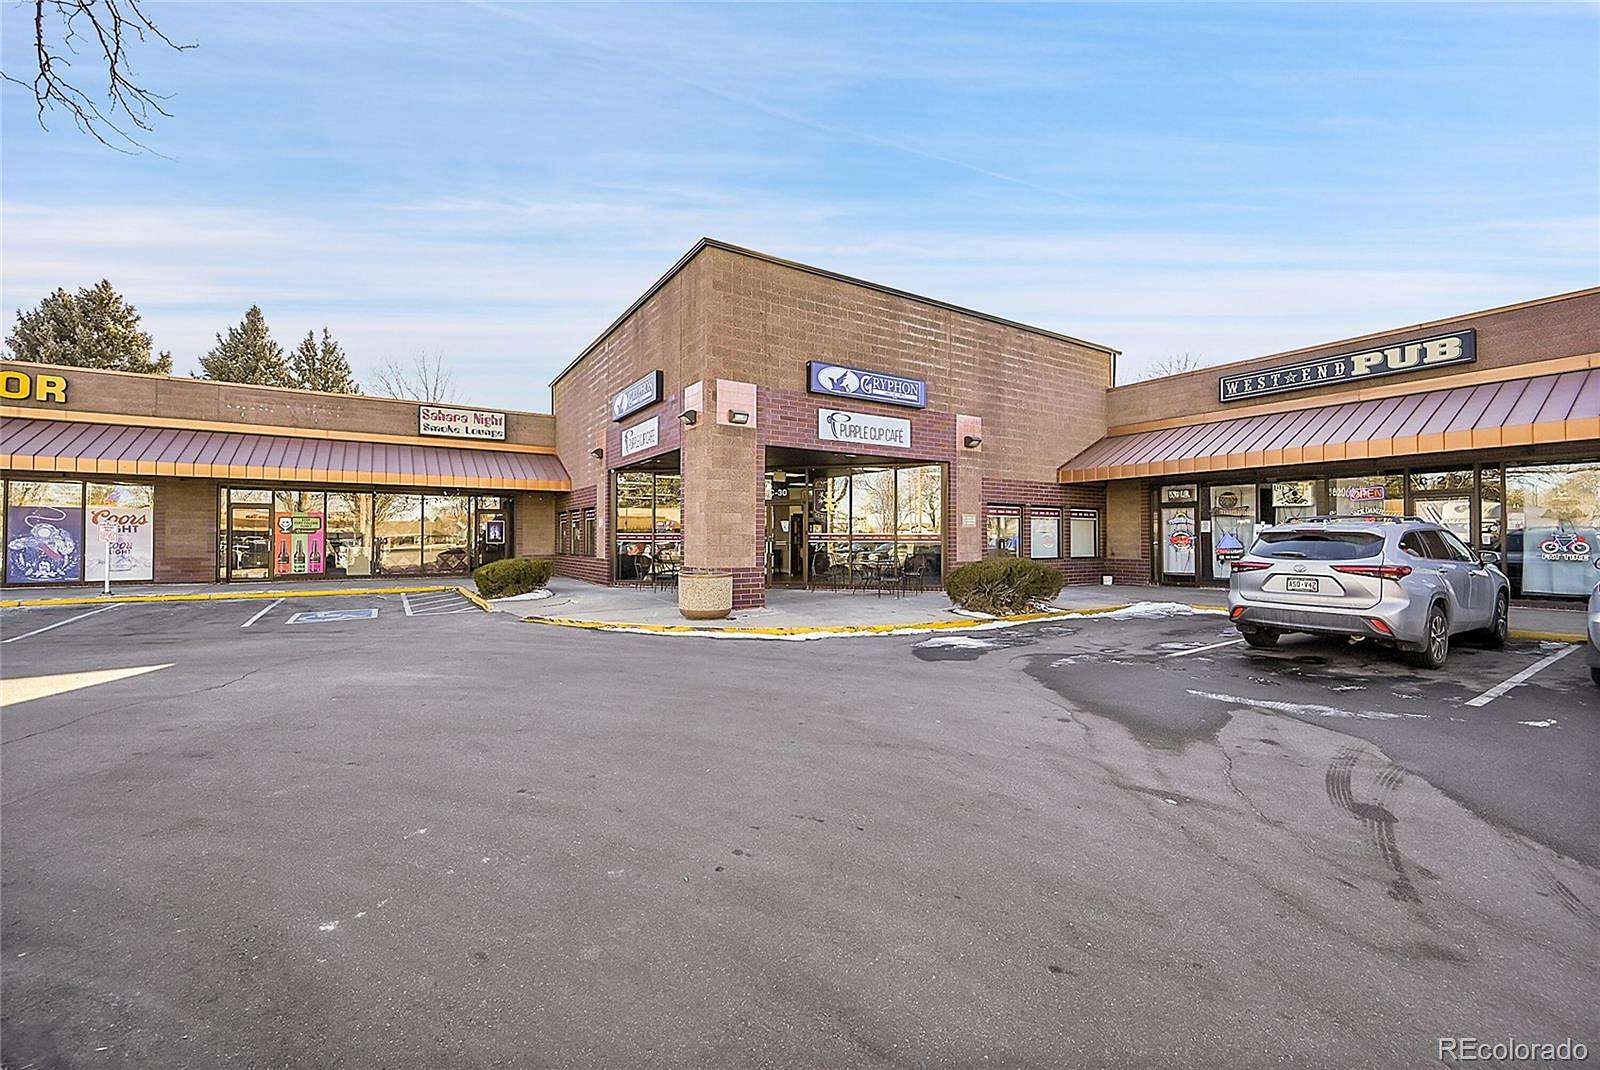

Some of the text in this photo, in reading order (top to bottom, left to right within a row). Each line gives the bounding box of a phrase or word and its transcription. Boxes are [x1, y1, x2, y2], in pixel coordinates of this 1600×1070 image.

[1225, 337, 1463, 395] WEST END PUB
[860, 374, 919, 396] GRYPHON
[422, 408, 503, 428] Sahara Night
[422, 422, 503, 438] Smoke Lounge
[839, 423, 869, 441] PURPLE
[870, 426, 885, 441] CUP
[1352, 489, 1382, 499] OPEN
[91, 509, 148, 525] Coors
